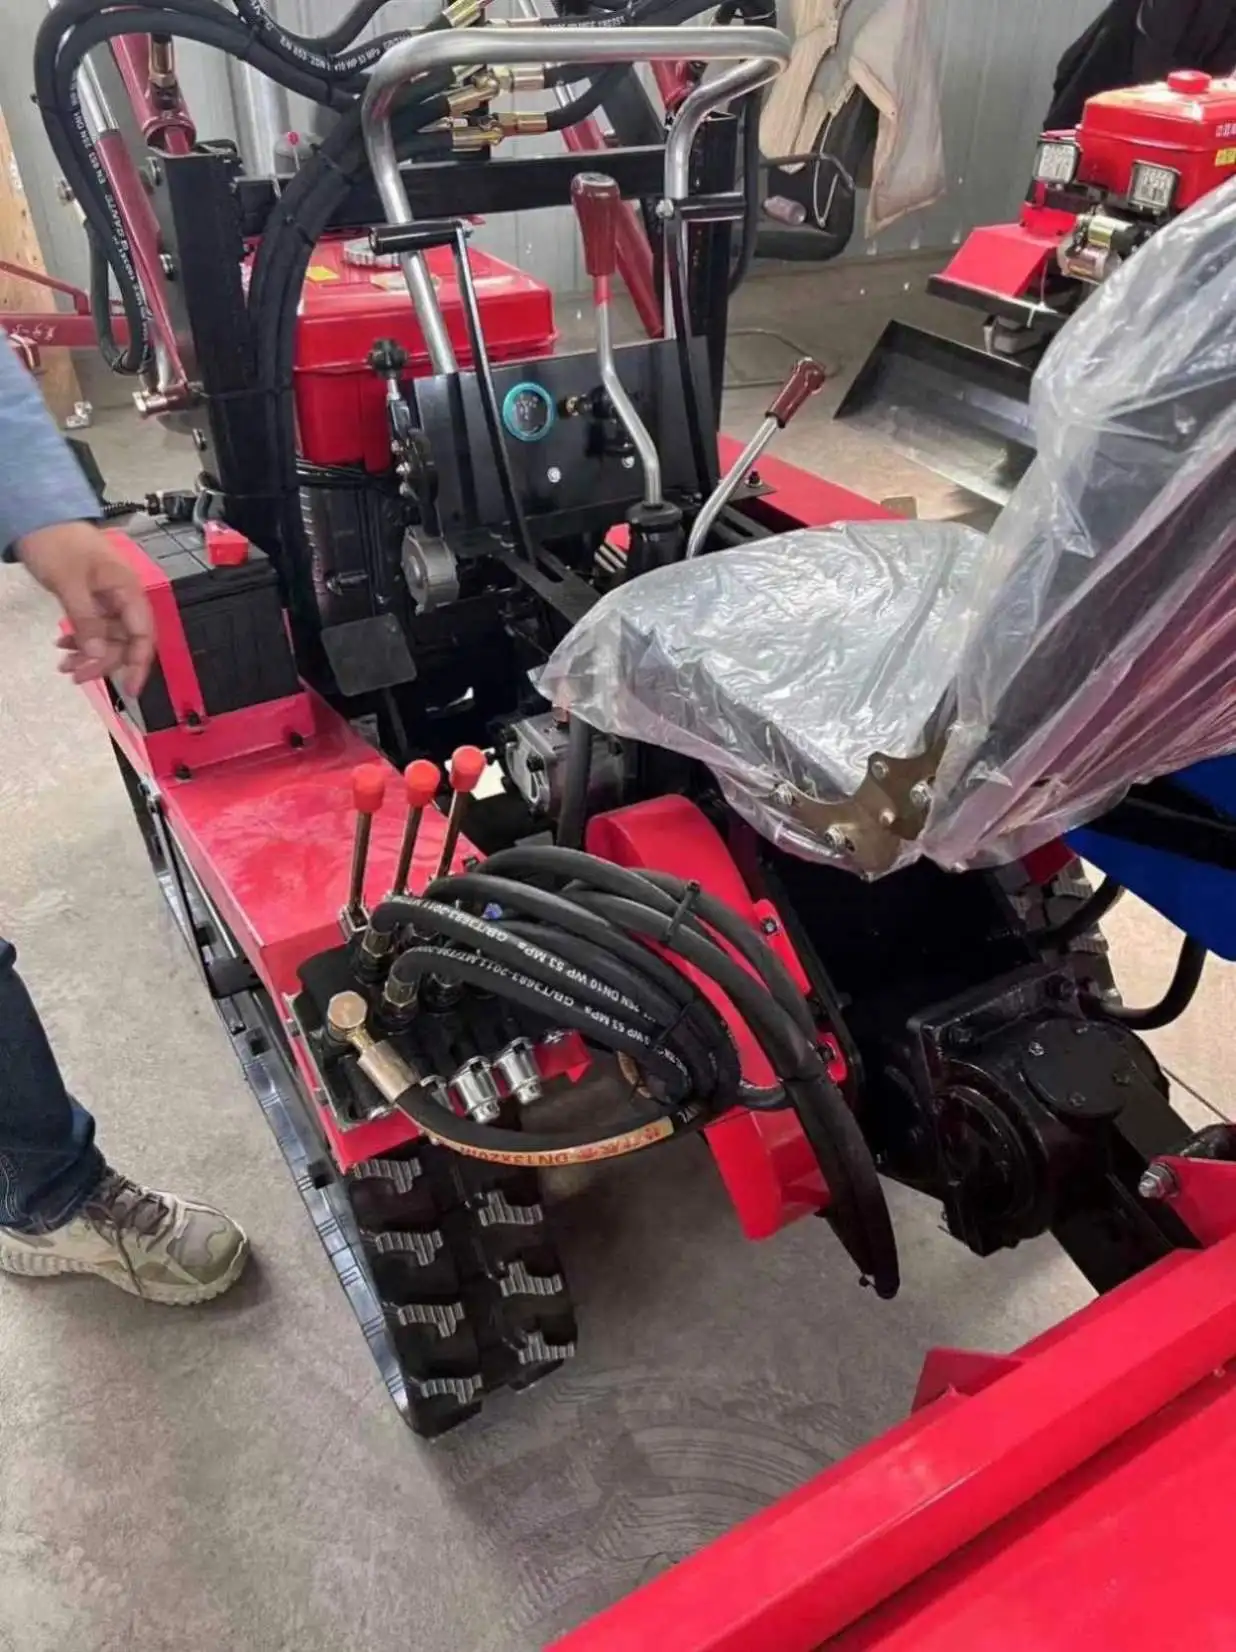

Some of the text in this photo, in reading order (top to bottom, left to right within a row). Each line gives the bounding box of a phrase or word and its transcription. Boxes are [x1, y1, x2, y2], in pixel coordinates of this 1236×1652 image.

[516, 940, 548, 964] MPa
[548, 956, 565, 972] 53
[566, 967, 588, 985] WP
